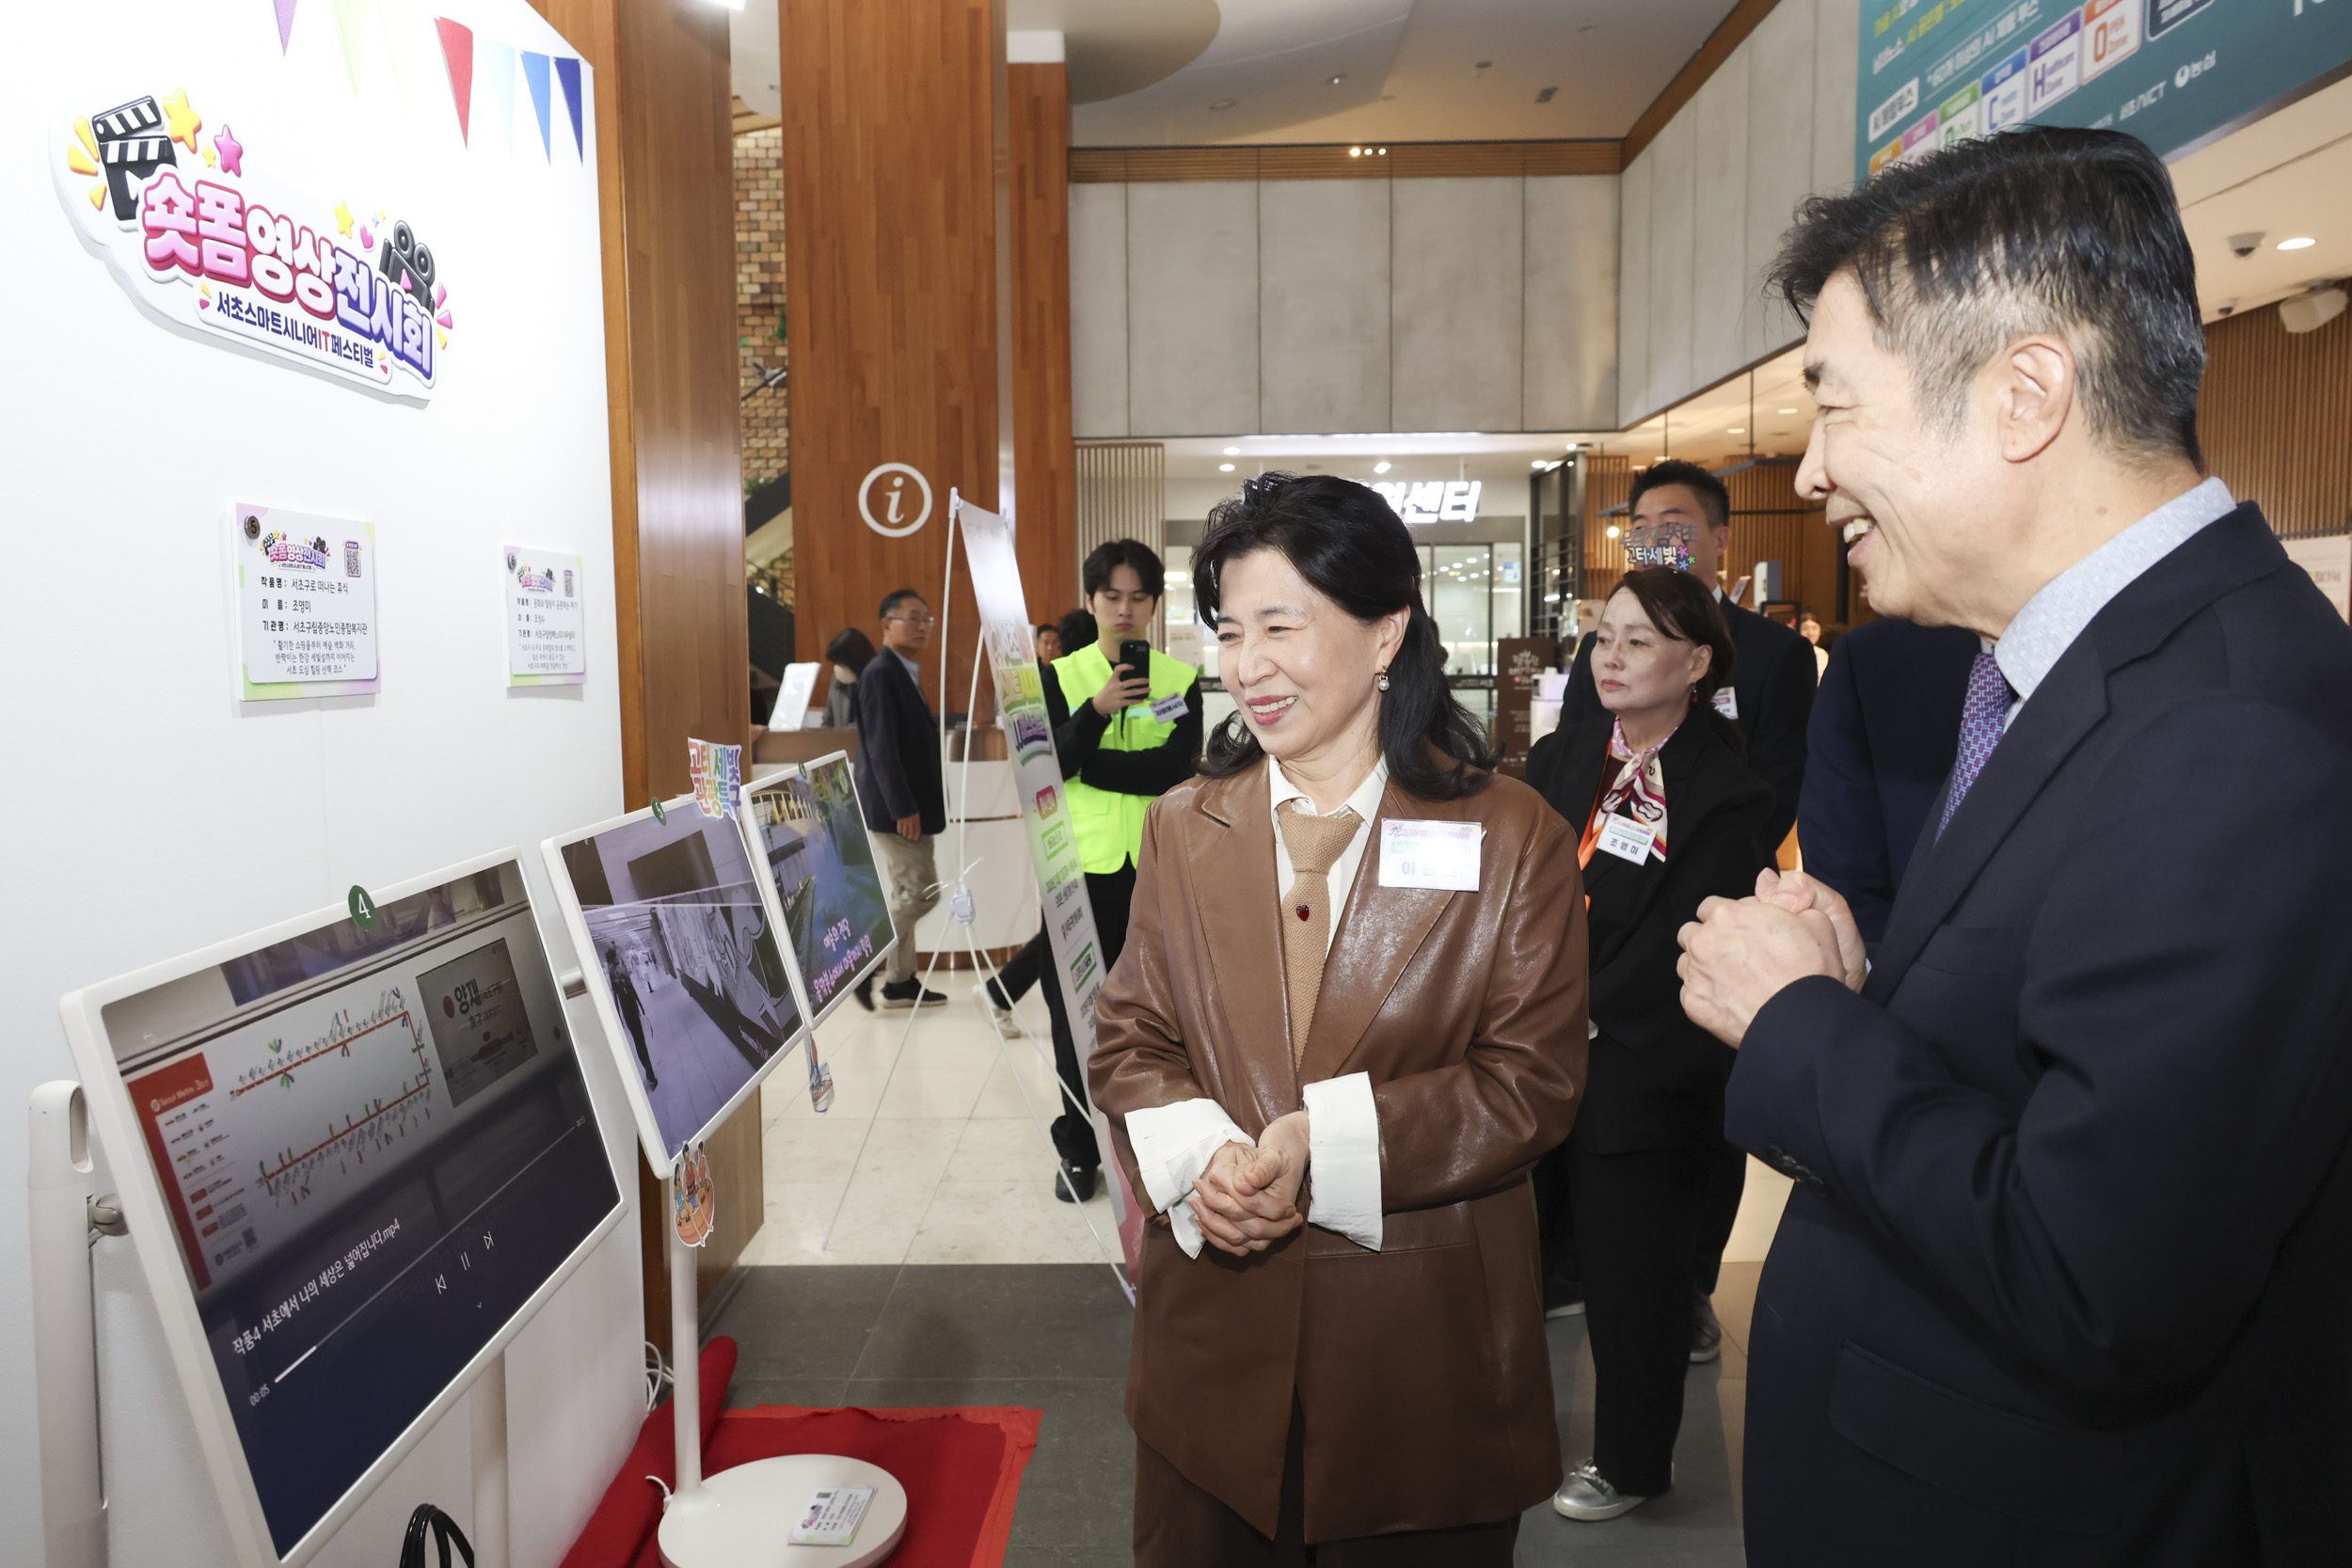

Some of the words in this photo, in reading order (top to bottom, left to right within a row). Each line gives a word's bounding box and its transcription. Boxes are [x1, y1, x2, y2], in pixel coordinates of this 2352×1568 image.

[250, 520, 258, 534] 5
[292, 578, 316, 593] 서초구로
[317, 580, 335, 594] 떠나는
[337, 581, 349, 594] 휴식
[293, 599, 311, 613] 조영미
[689, 741, 712, 778] 고터
[714, 746, 741, 784] 세빛
[693, 776, 741, 817] 관광특구
[358, 893, 372, 919] 4
[454, 977, 483, 1015] 양재
[231, 1325, 262, 1355] 작품4
[262, 1293, 301, 1333] 서초에서
[298, 1278, 320, 1303] 나의
[318, 1259, 345, 1288] 세상은
[248, 1384, 271, 1407] 00:05
